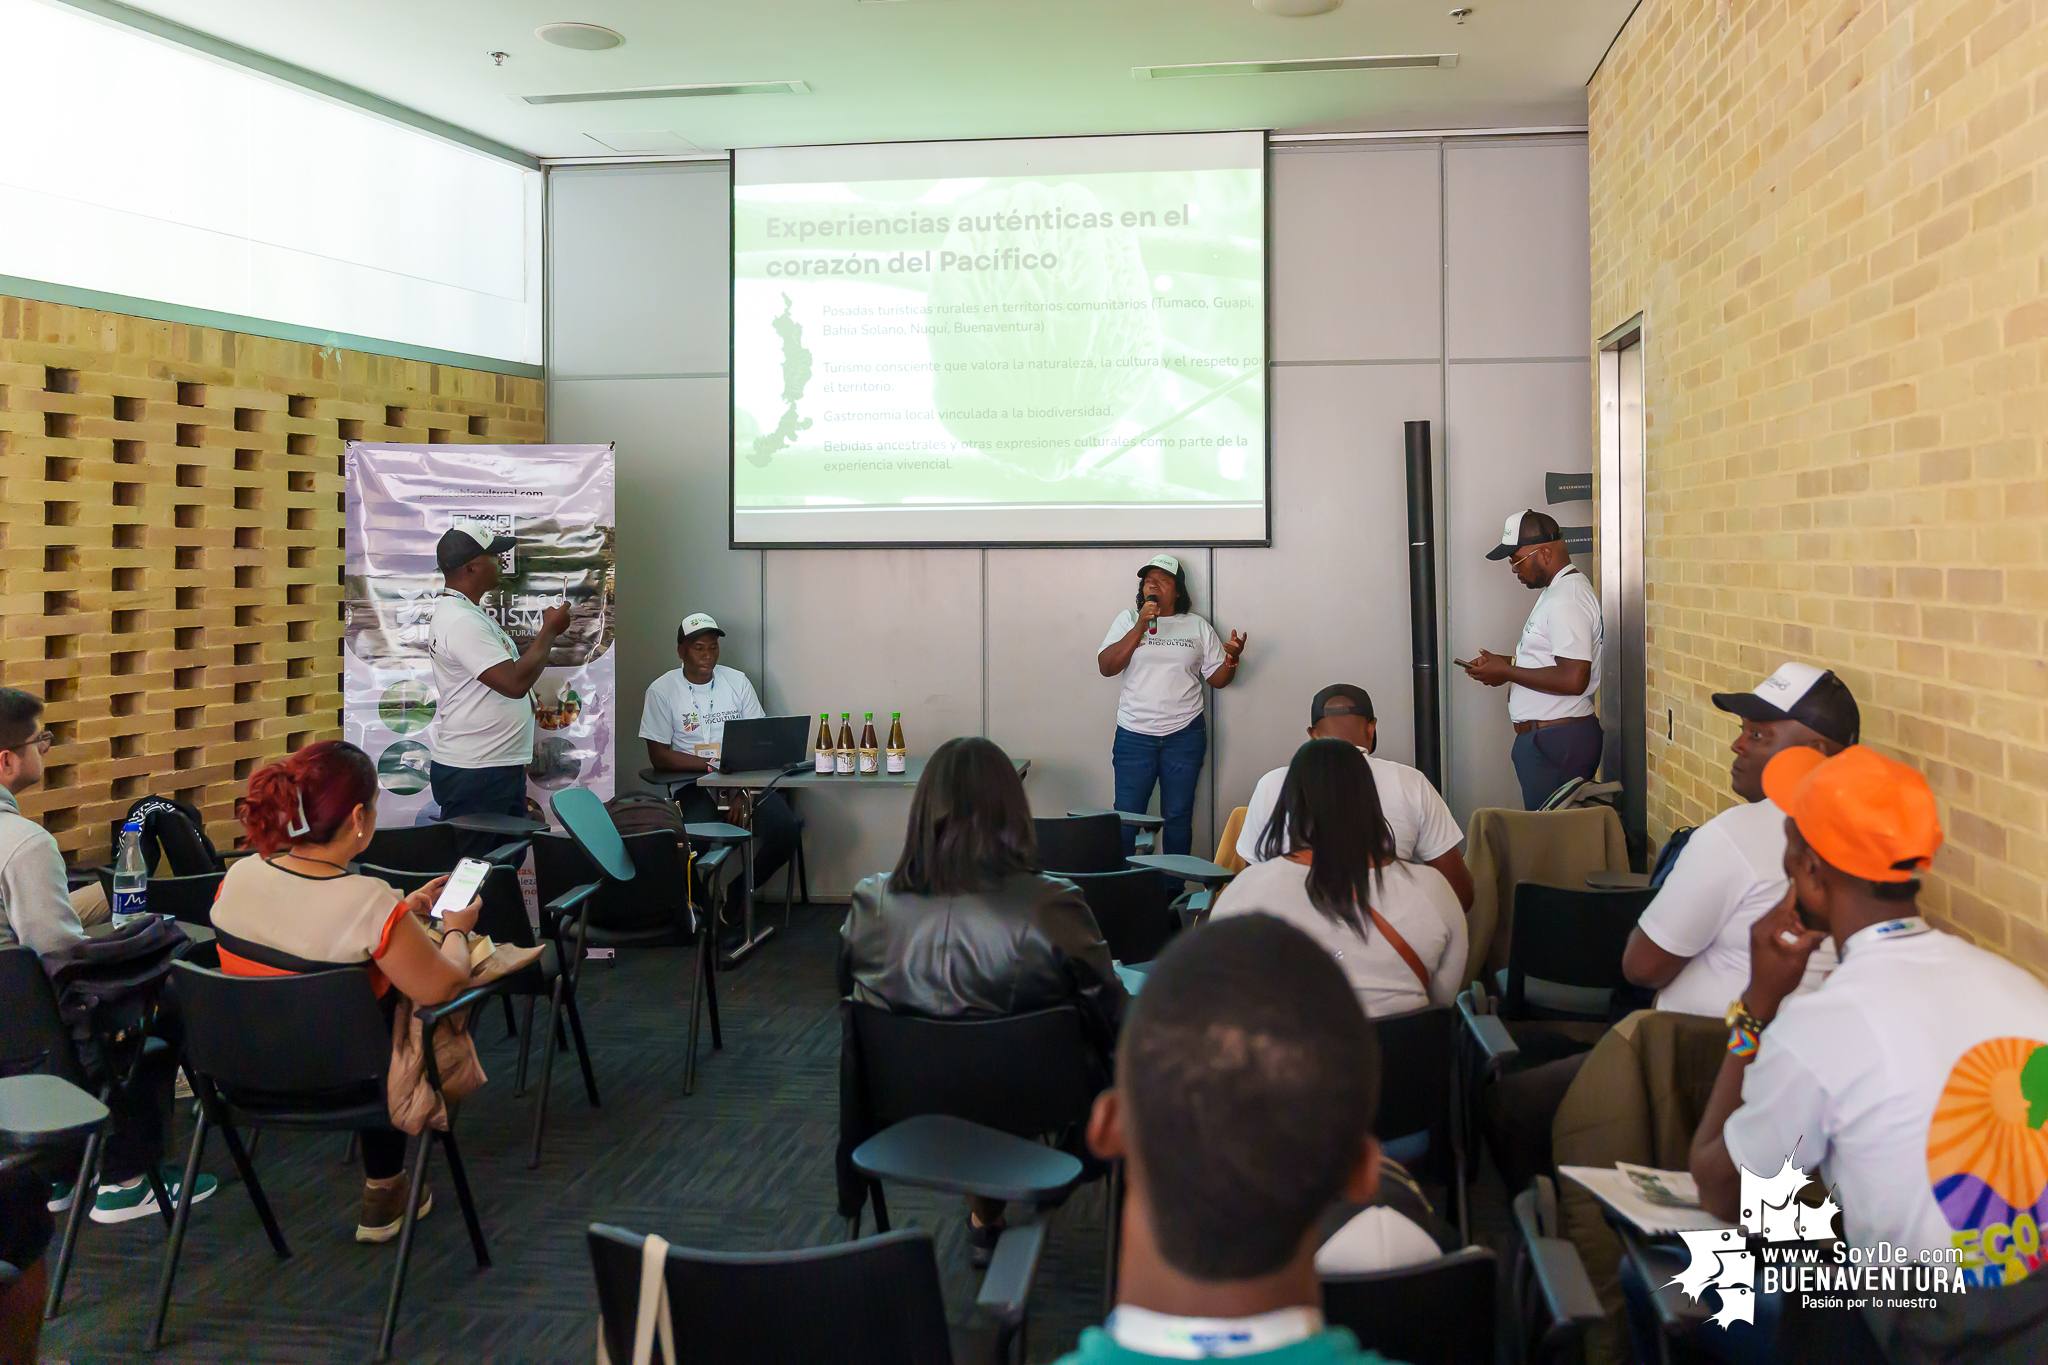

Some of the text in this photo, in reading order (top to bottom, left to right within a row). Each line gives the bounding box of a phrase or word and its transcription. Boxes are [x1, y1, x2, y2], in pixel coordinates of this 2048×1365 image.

[766, 203, 1189, 242] Experiencias auténticas en el
[766, 247, 1058, 277] corazón del Pacífico
[822, 296, 1254, 317] Posadas turísticas rurales en territorios comunitarios (Tumaco, Guapi,
[823, 320, 1045, 336] Bahía Solano, Nuquí, Buenaventura)
[823, 362, 872, 373] Turismo
[875, 359, 941, 373] consciente
[944, 361, 968, 374] que
[970, 359, 1009, 371] valora
[1013, 358, 1024, 370] la
[1028, 357, 1097, 370] naturaleza,
[1100, 356, 1112, 368] la
[1115, 356, 1160, 368] cultura
[1162, 358, 1171, 368] y
[1174, 355, 1188, 367] el
[1190, 356, 1239, 369] respeto
[823, 381, 894, 393] el territorio.
[823, 405, 1114, 422] Gastronomía local vinculada a la biodiversidad.
[824, 434, 1248, 452] Bebidas ancestrales y otras expresiones culturales como parte de la
[824, 458, 954, 473] experiencia vivencial.
[482, 590, 564, 607] CÍFICO
[1950, 1213, 2040, 1269] ECO
